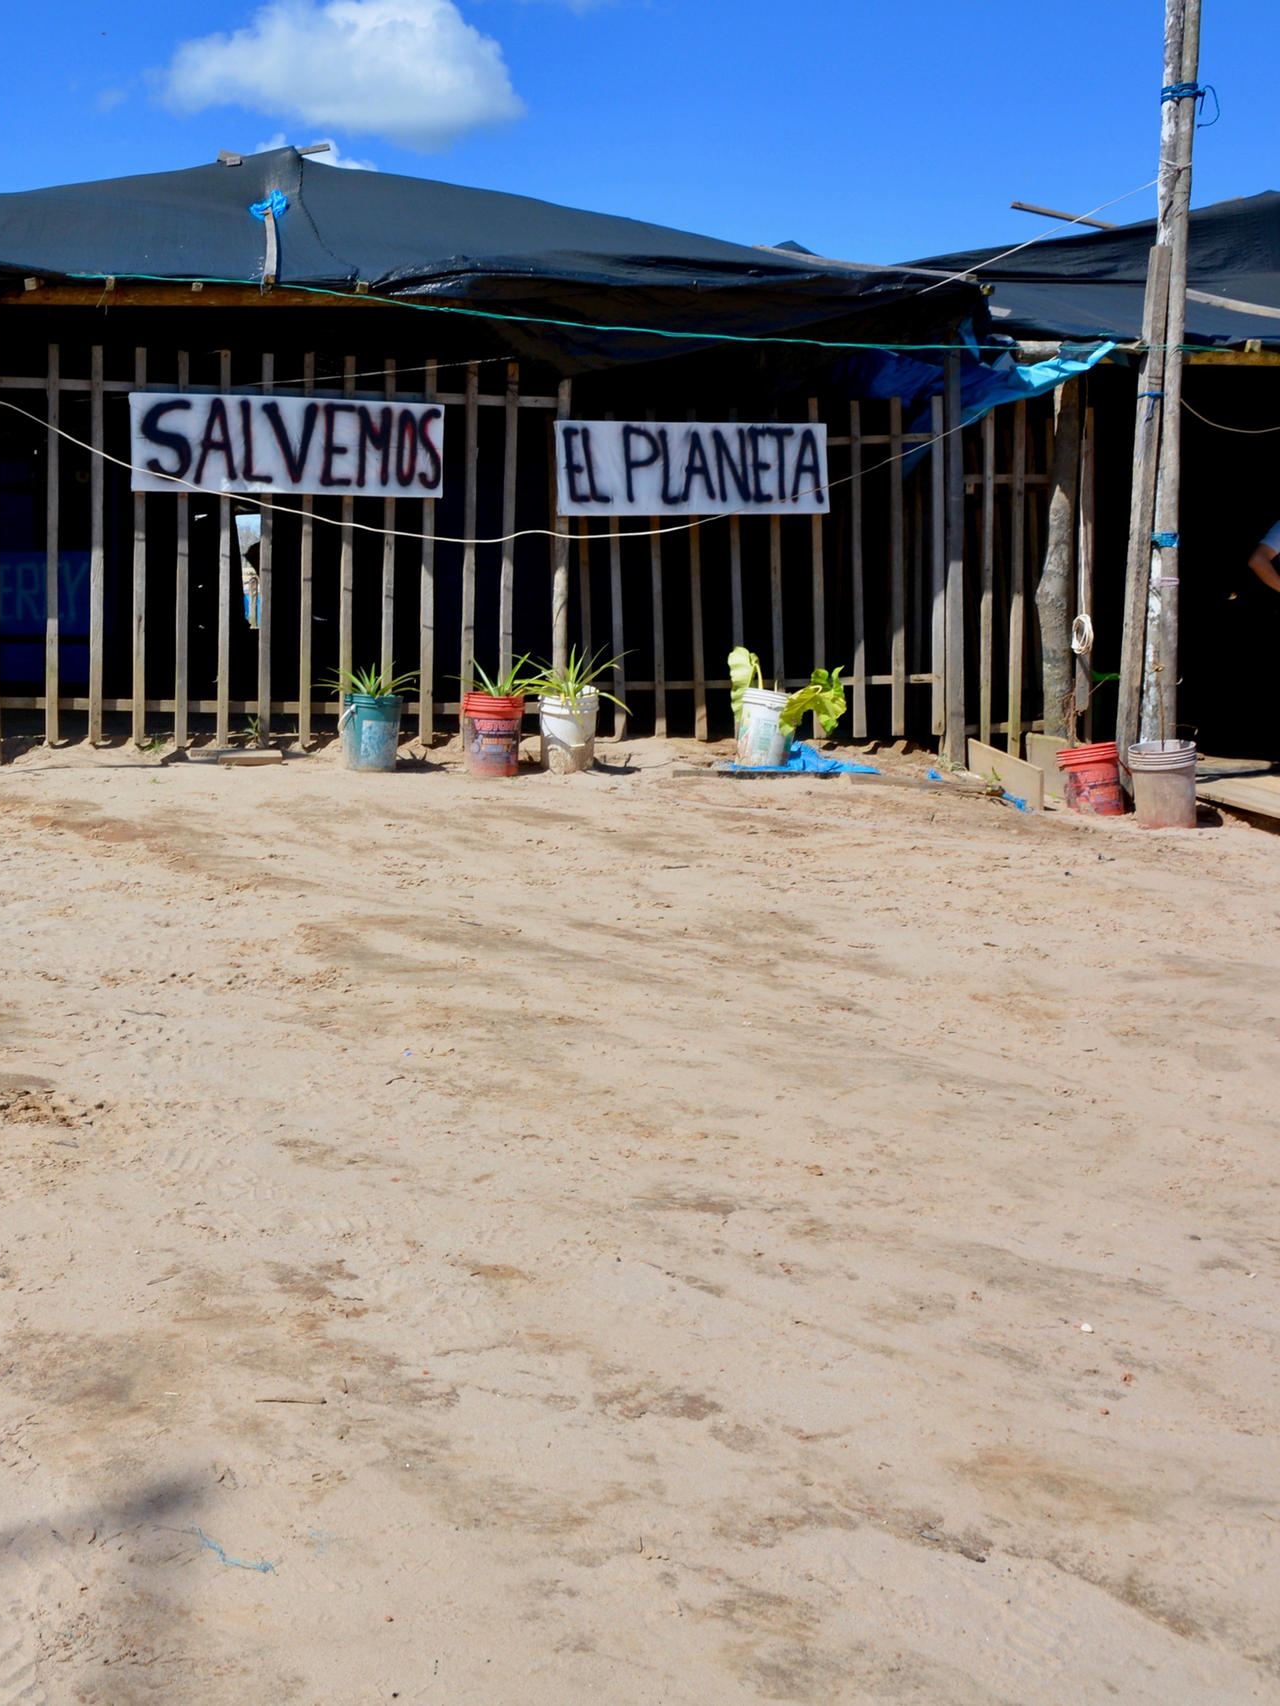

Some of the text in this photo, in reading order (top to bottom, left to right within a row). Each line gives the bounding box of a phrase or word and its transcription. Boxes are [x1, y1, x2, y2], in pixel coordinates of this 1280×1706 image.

[140, 398, 442, 490] SALVEMOS
[562, 424, 825, 505] EL PLANETA
